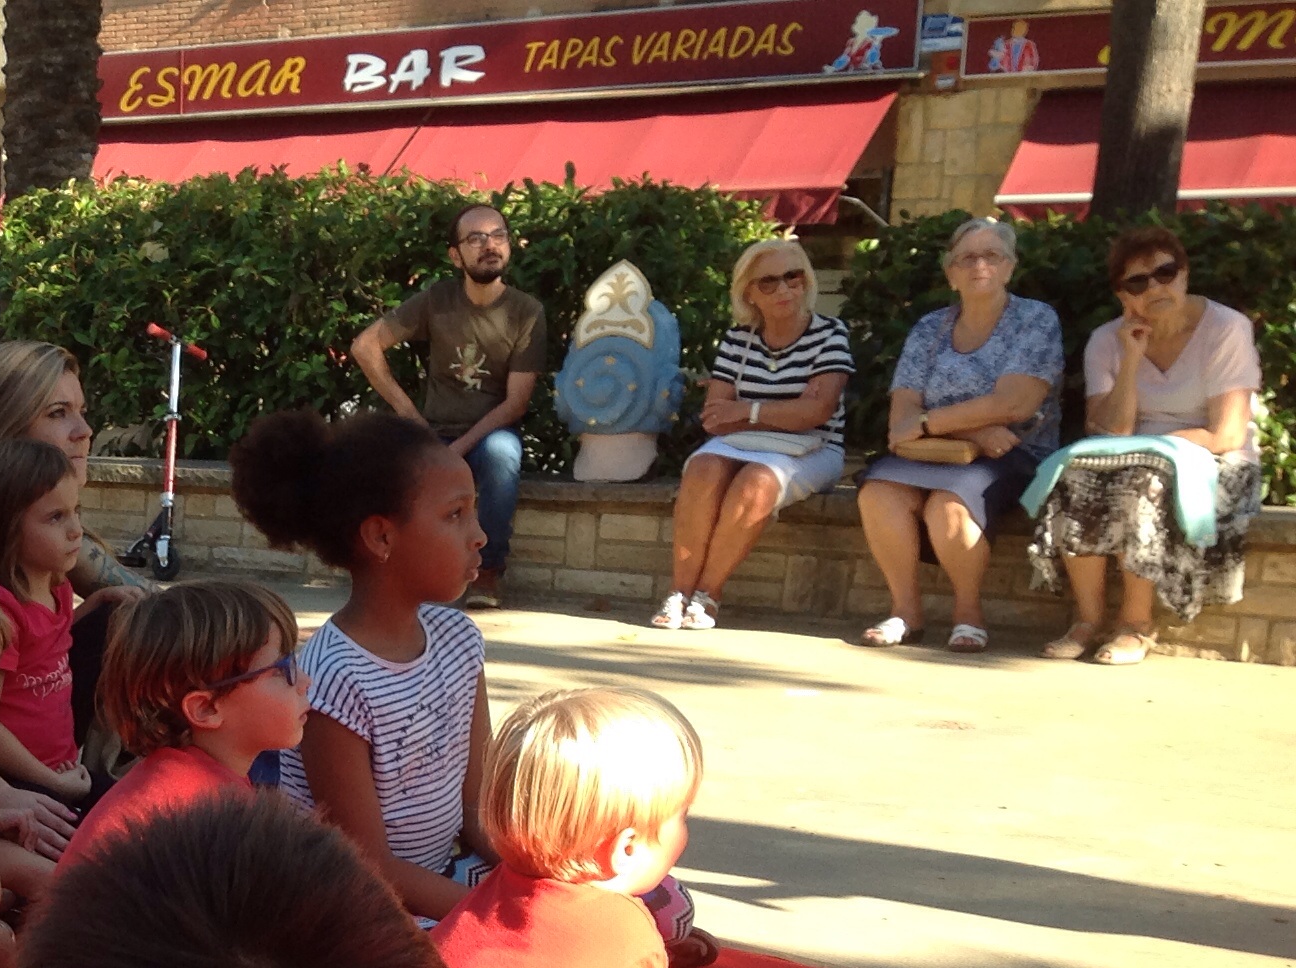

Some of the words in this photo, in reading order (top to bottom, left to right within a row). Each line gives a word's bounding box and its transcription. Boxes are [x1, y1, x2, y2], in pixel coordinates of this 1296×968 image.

[118, 55, 307, 114] ESMAR
[343, 44, 487, 95] BAR
[523, 34, 625, 74] TAPAS
[631, 21, 804, 66] VARIADAS
